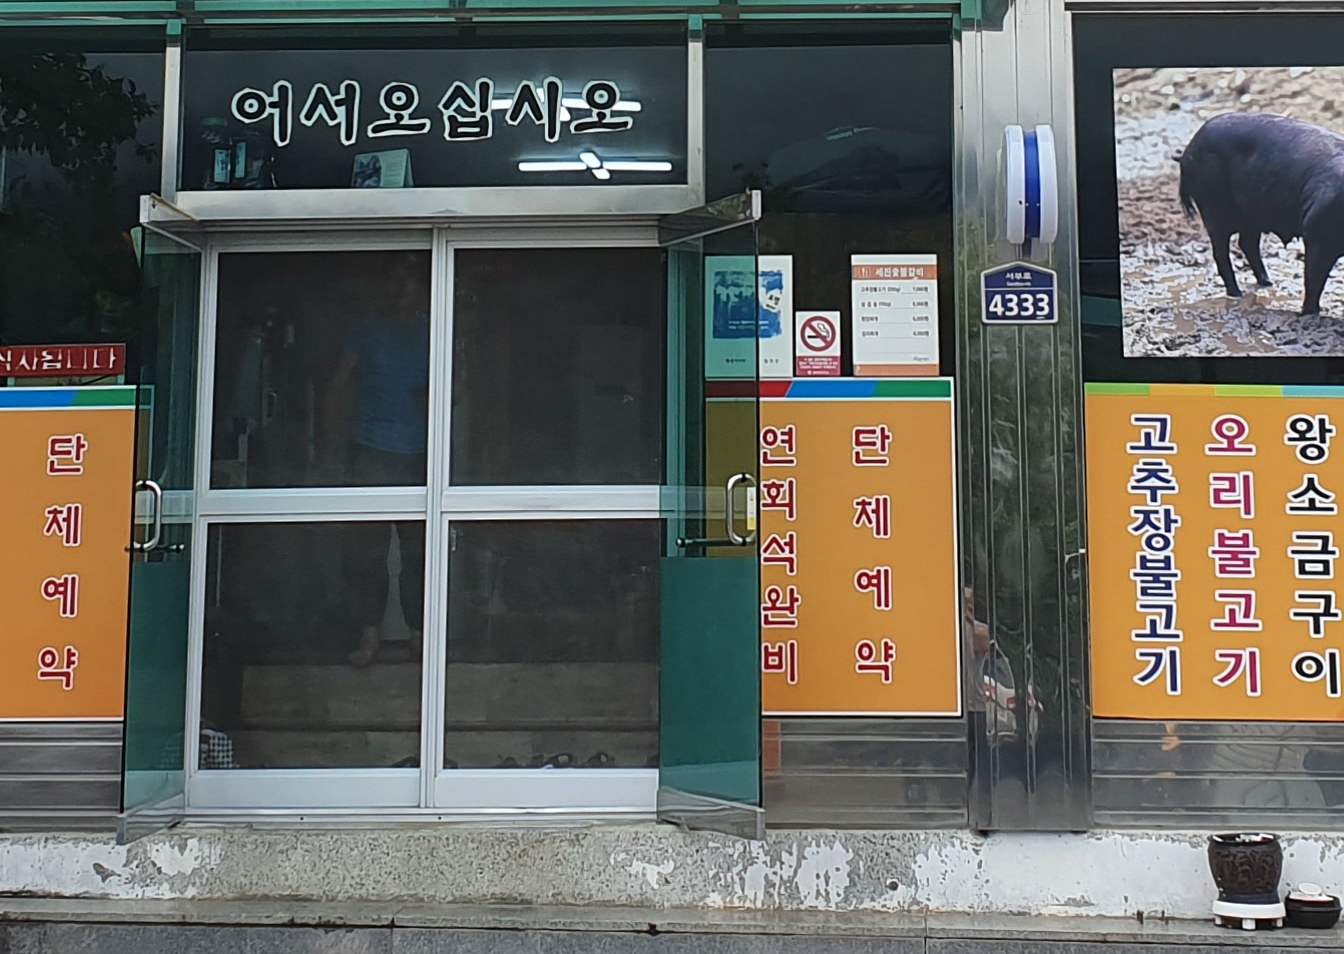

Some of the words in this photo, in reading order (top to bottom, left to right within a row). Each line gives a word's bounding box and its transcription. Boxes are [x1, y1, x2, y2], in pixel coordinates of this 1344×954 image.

[231, 76, 634, 148] 어서오십시오
[989, 293, 1050, 317] 4333
[760, 425, 801, 684] 연회석완비
[1126, 413, 1183, 695] 고추장불고기
[1205, 414, 1262, 697] 오리불고기
[1285, 415, 1342, 698] 왕소금구이
